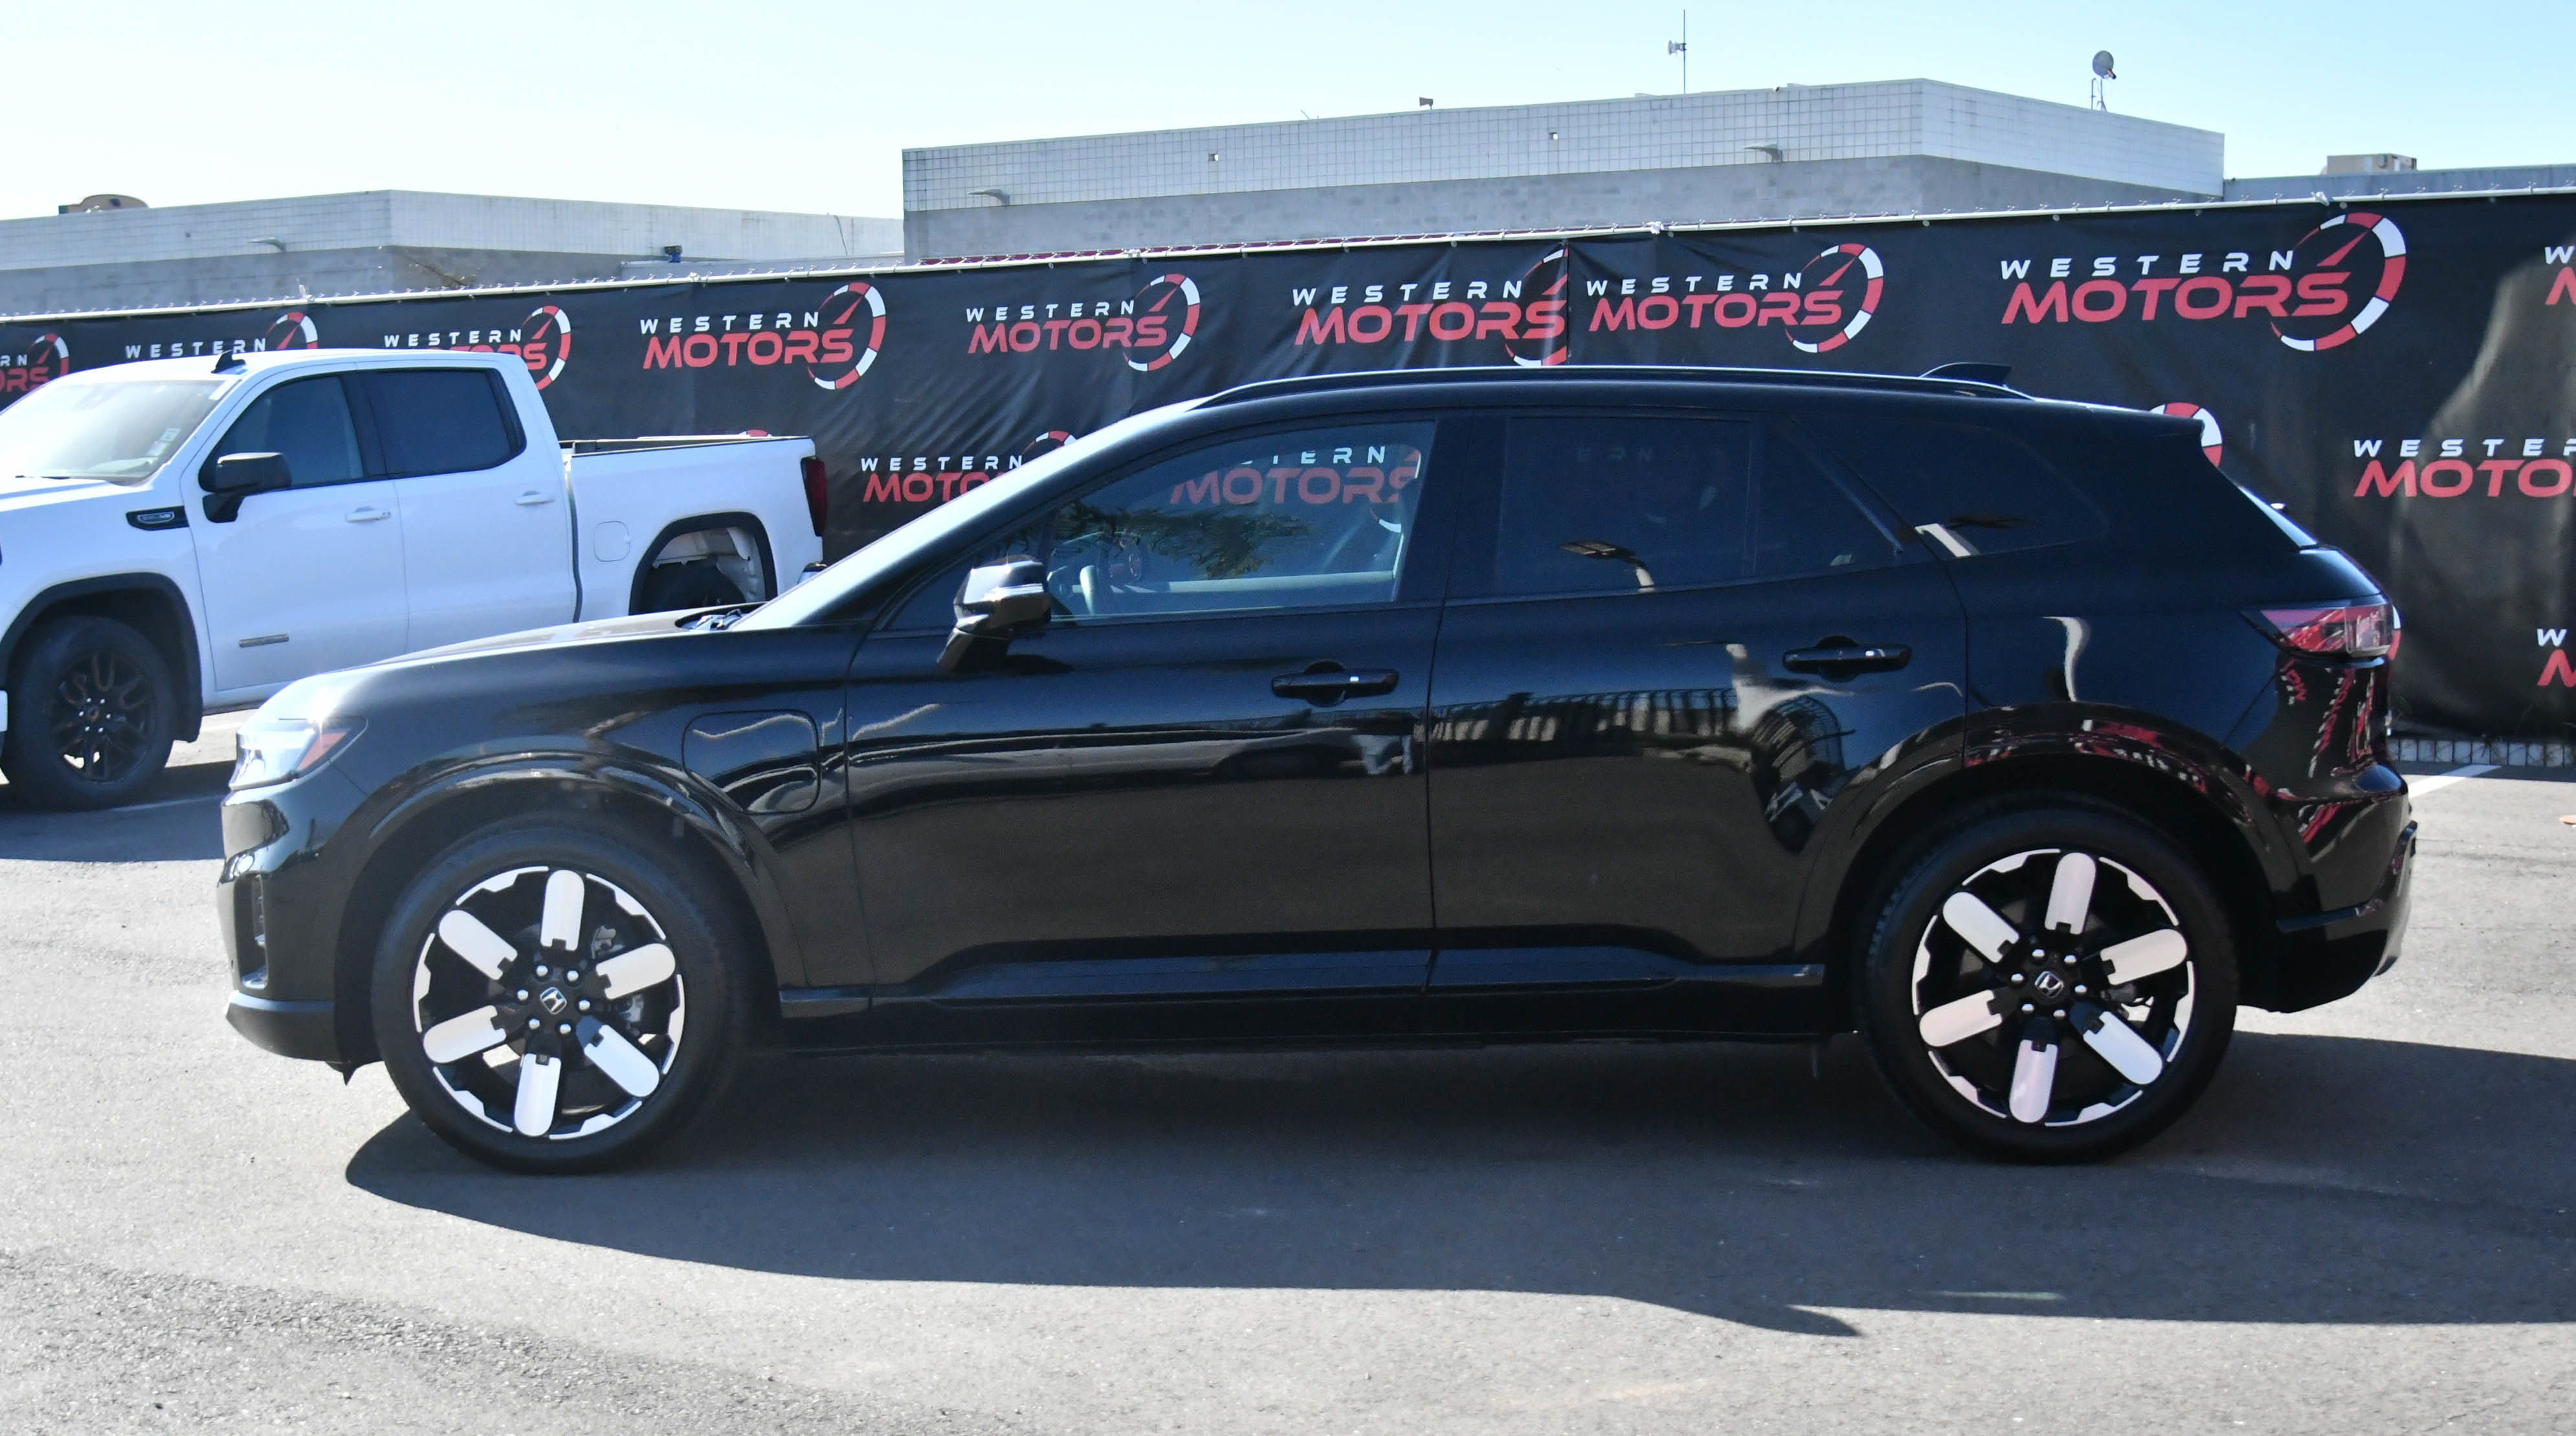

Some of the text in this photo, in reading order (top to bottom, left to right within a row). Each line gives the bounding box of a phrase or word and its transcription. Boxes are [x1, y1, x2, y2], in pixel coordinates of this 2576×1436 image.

[2001, 250, 2293, 280] WESTERN
[1293, 280, 1522, 306] WESTERN
[1586, 272, 1801, 296] WESTERN
[2002, 272, 2351, 324] MOTORS
[640, 311, 819, 335] WESTERN
[966, 300, 1135, 322] WESTERN
[1296, 300, 1566, 344] MOTORS
[1589, 289, 1843, 332] MOTORS
[126, 337, 267, 359] WESTERN
[384, 329, 522, 348] WESTERN
[643, 329, 853, 370] MOTORS
[969, 315, 1167, 354] MOTORS
[861, 455, 1023, 473] WESTERN
[2355, 458, 2576, 498] MOTO
[864, 472, 1005, 502] MOTO
